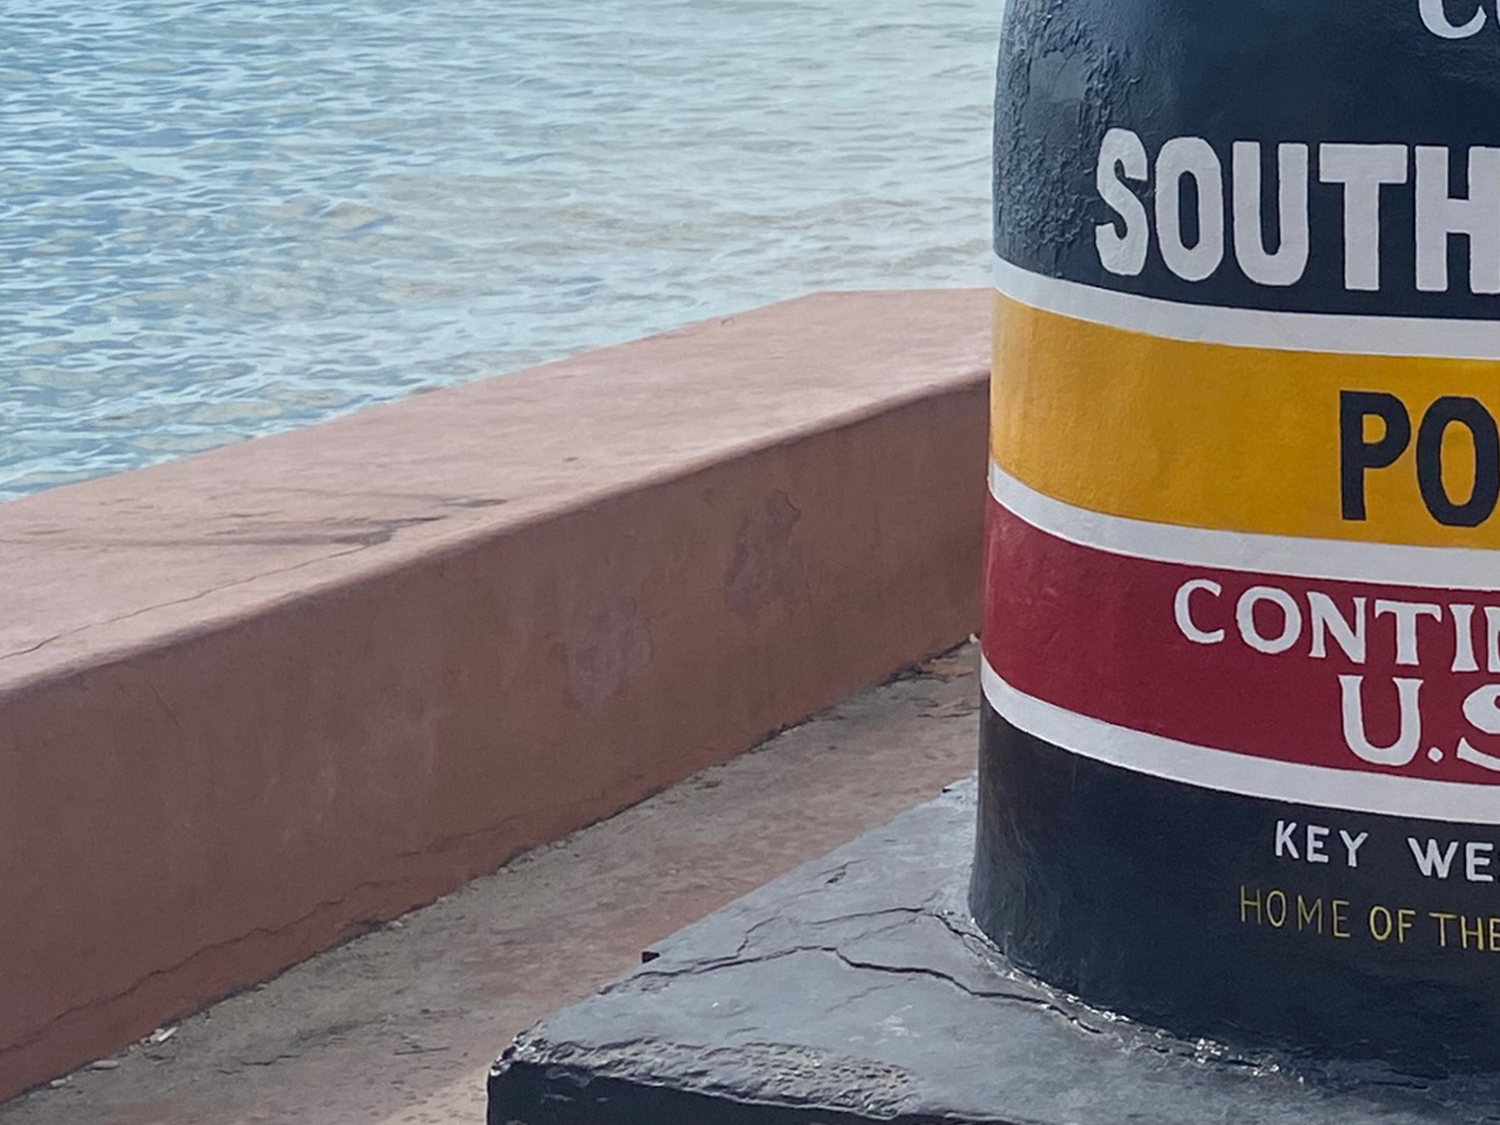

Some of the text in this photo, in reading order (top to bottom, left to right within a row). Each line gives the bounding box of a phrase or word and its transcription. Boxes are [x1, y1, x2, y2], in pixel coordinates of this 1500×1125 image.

[1274, 820, 1369, 868] KEY
[1238, 885, 1351, 938] HOME
[1368, 905, 1413, 945] OF
